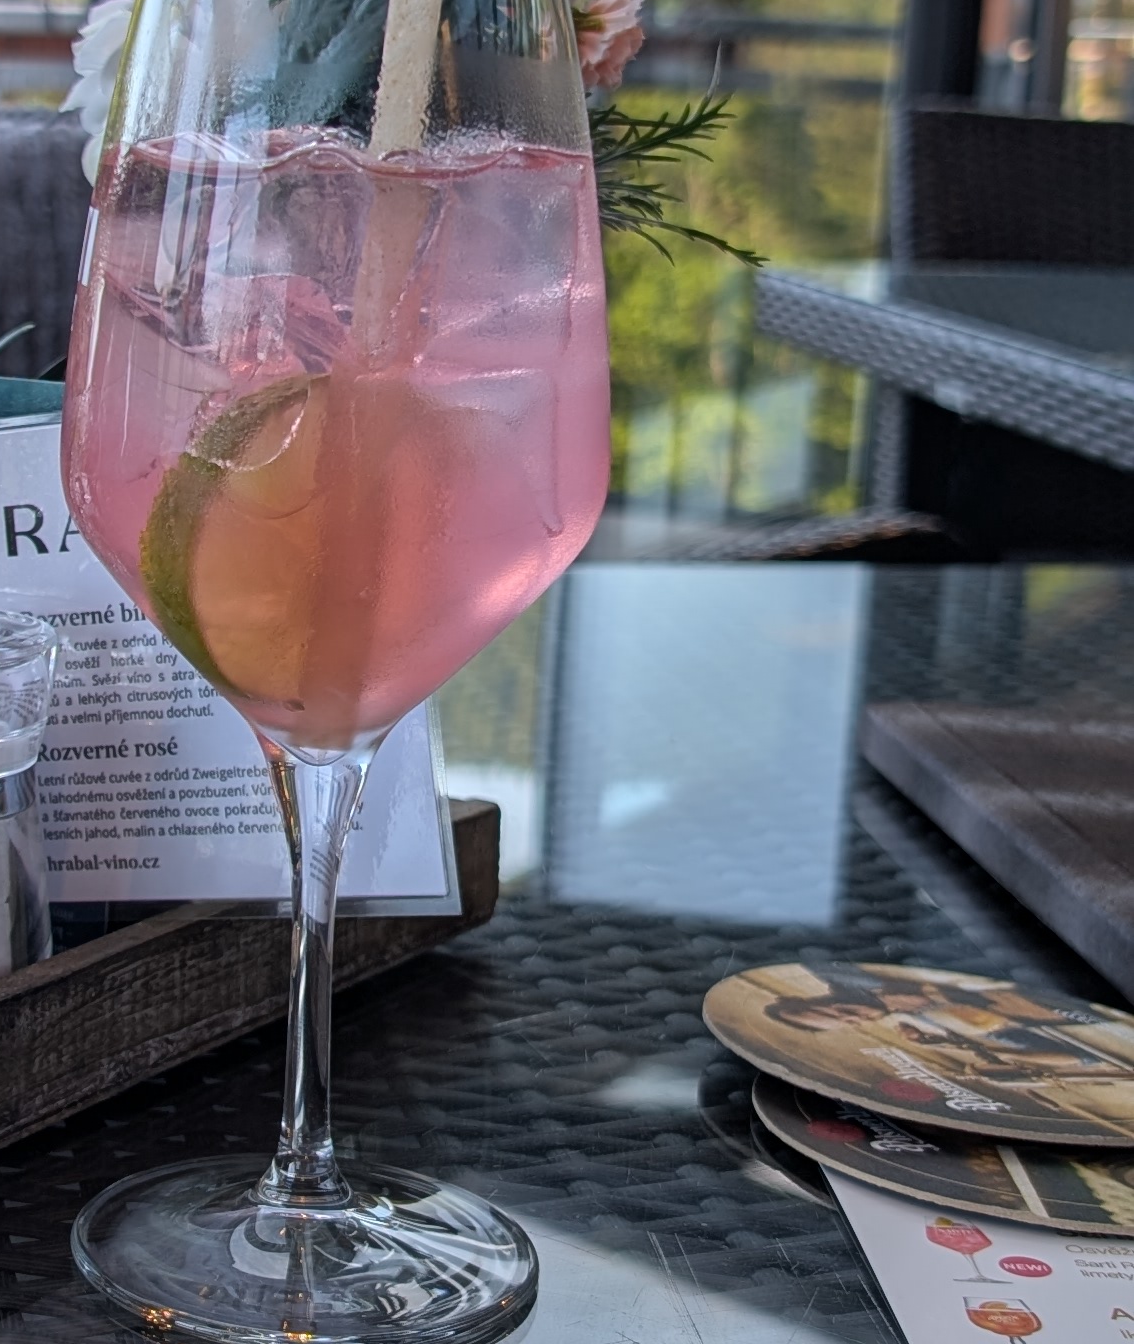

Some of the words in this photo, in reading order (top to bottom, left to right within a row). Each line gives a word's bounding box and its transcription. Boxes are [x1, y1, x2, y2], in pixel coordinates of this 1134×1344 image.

[20, 604, 115, 628] zverné
[74, 638, 107, 651] cuvée
[121, 634, 156, 648] odrůd
[64, 656, 100, 670] osvěží
[155, 652, 177, 667] dny
[127, 671, 152, 684] víno
[171, 670, 203, 682] atra
[77, 690, 122, 707] lehkých
[127, 687, 193, 703] citrusových
[71, 711, 102, 724] velmi
[104, 709, 164, 725] příjemnou
[167, 704, 214, 719] dochutí.
[37, 738, 129, 762] Rozverné
[134, 736, 179, 758] rosé
[37, 774, 65, 787] Letní
[68, 771, 106, 785] růžové
[109, 770, 142, 784] cuvée
[154, 767, 189, 782] odrůd
[39, 792, 46, 804] k
[49, 791, 113, 804] lahodnému
[116, 787, 165, 802] osvěžení
[179, 784, 249, 801] povzbuzení.
[120, 806, 180, 820] červeného
[185, 806, 219, 817] ovoce
[43, 827, 82, 840] lesních
[85, 826, 121, 842] jahod,
[123, 825, 155, 838] malin
[168, 822, 235, 836] chlazeného
[47, 854, 160, 872] hrabal-vino.cz
[1003, 1261, 1048, 1272] NEW!
